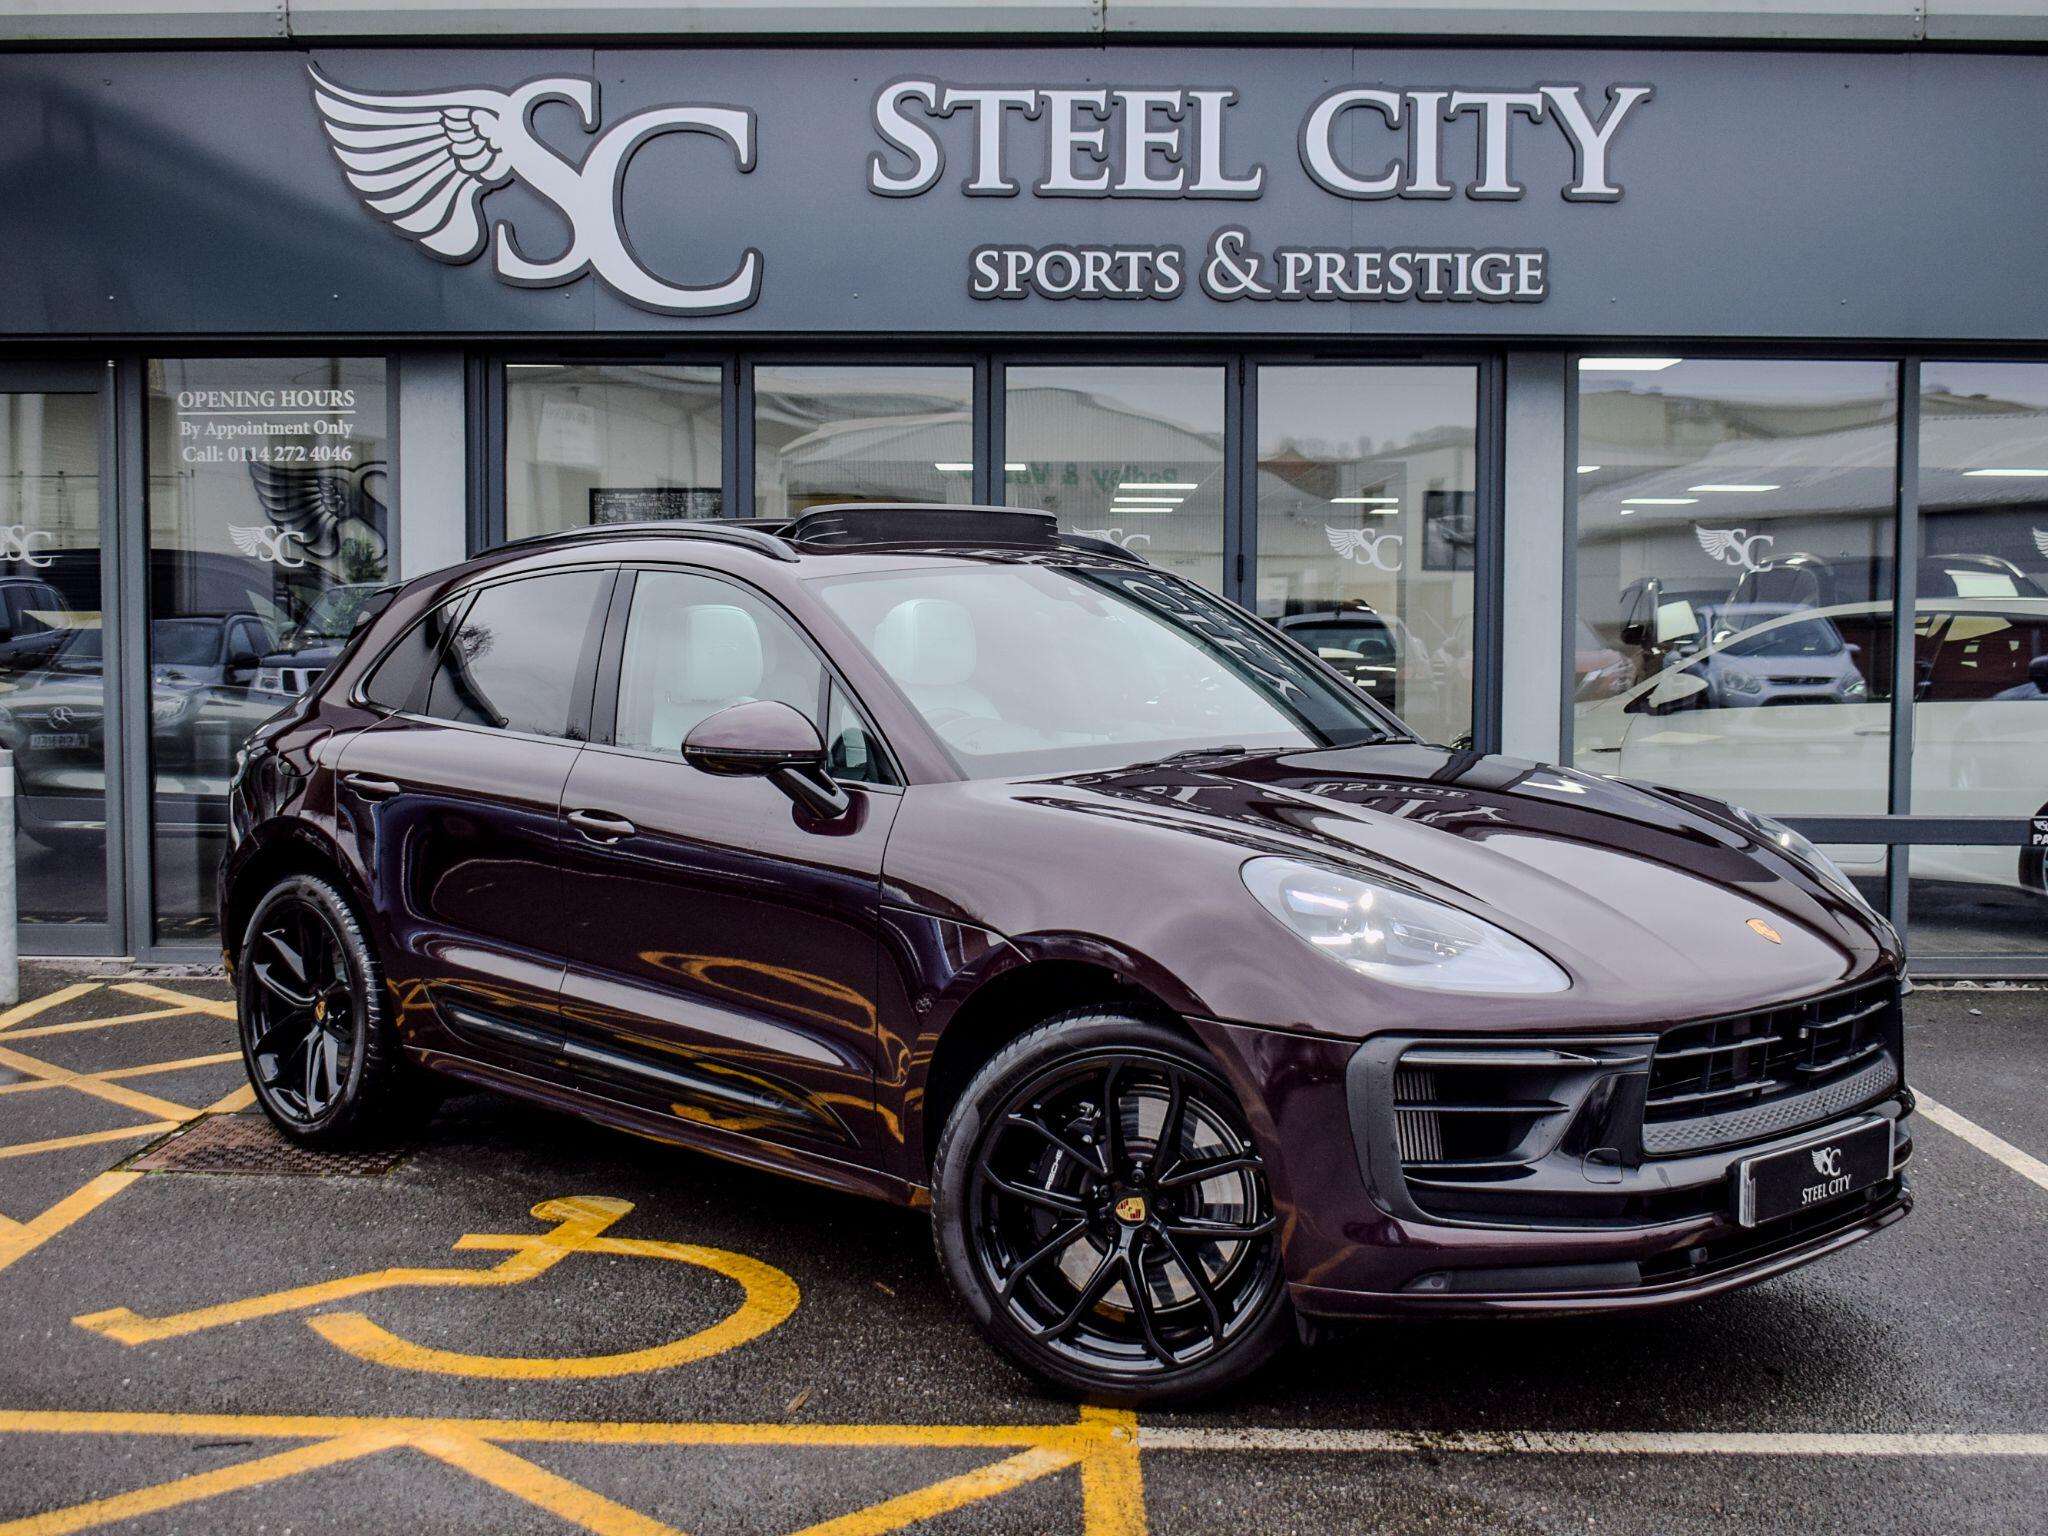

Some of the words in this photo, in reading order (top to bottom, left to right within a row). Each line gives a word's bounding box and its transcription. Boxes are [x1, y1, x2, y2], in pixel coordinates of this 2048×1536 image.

[872, 80, 1263, 192] STEEL
[1304, 85, 1653, 195] CITY
[496, 78, 756, 309] SC
[974, 249, 1181, 294] SPORTS
[1206, 230, 1272, 295] &
[1280, 251, 1545, 296] PRESTIGE
[177, 390, 275, 408] OPENING
[280, 389, 355, 407] HOURS
[180, 421, 200, 440] By
[204, 420, 311, 440] Appointment
[313, 419, 353, 439] Only
[182, 445, 223, 463] Call:
[227, 446, 270, 462] 0114
[273, 445, 306, 462] 272
[309, 445, 352, 461] 4046
[1802, 1183, 1827, 1204] STEEL
[1829, 1174, 1851, 1195] CITY
